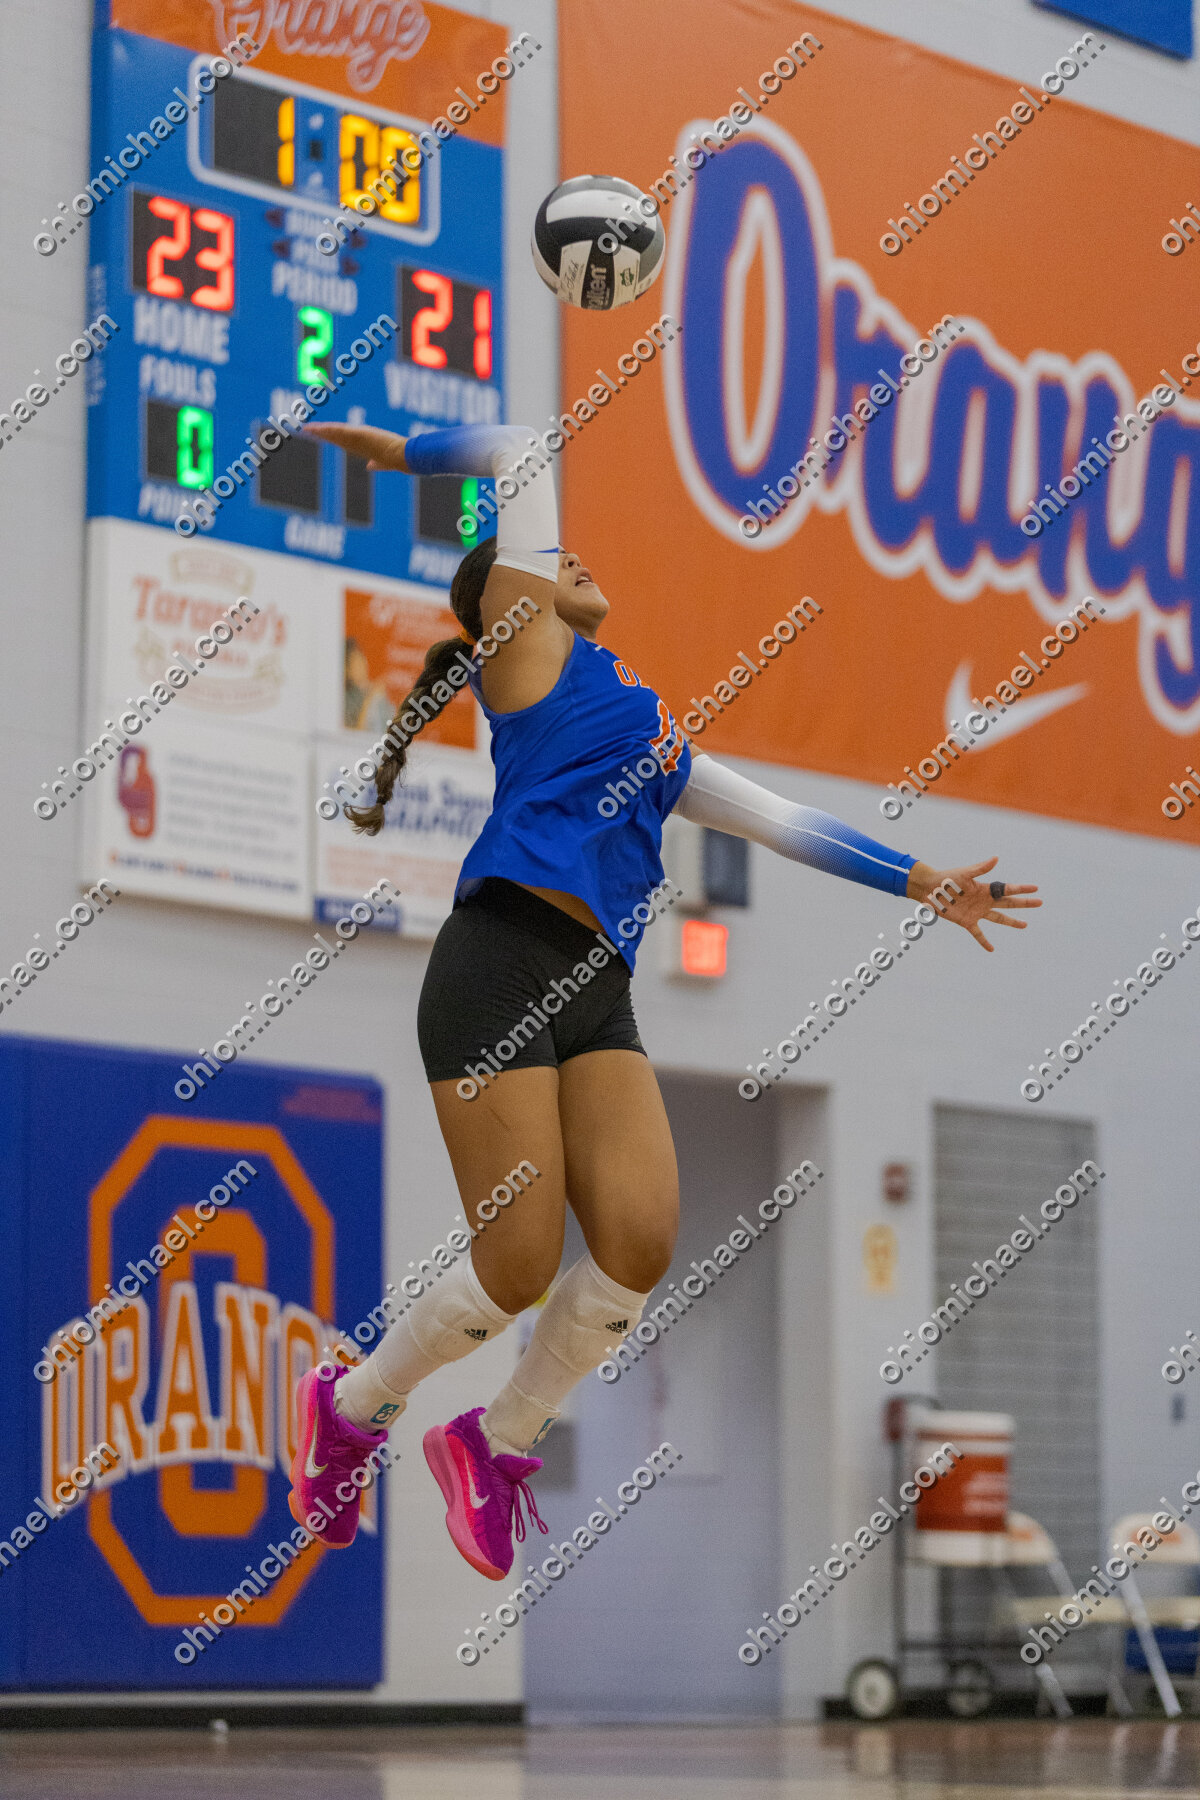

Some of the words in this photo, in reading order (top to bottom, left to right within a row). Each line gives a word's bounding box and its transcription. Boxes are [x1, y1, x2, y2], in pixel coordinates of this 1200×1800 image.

[146, 195, 235, 312] 23
[271, 260, 357, 315] PERIOD
[586, 263, 608, 310] olten
[133, 295, 230, 365] HOME
[297, 305, 333, 387] 2
[409, 268, 494, 380] 21
[138, 353, 217, 408] FOULS
[383, 360, 503, 425] VISITOR
[176, 404, 214, 490] 0
[662, 117, 1200, 735] Orang
[459, 476, 479, 549] 1
[43, 1281, 377, 1534] ORAN
